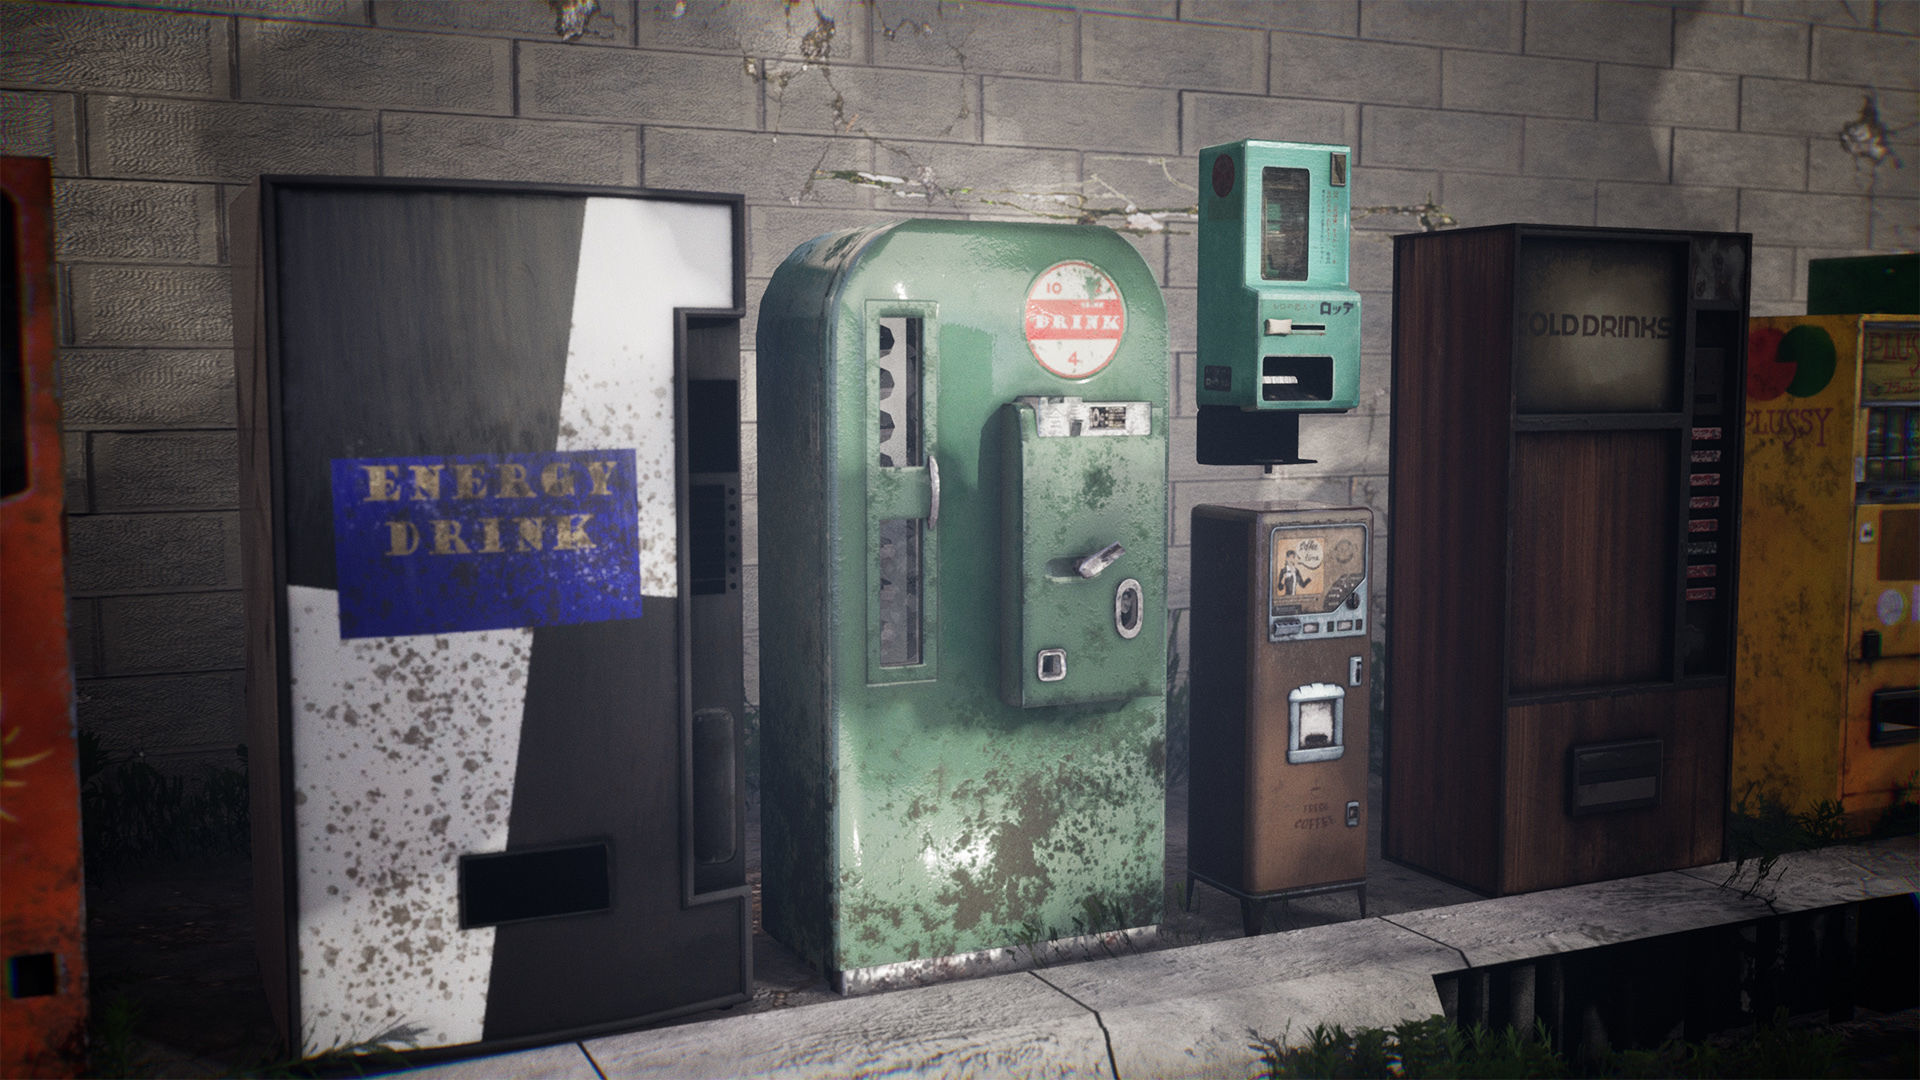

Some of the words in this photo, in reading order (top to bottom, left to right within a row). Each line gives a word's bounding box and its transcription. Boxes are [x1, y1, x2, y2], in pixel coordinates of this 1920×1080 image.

[1046, 282, 1062, 295] 10
[1320, 301, 1354, 315] ロッテ
[1034, 314, 1120, 331] DRINK
[1521, 312, 1579, 337] OLD
[1582, 315, 1673, 339] DRINKS
[1067, 352, 1080, 366] 4
[358, 461, 618, 502] ENERGY
[384, 514, 598, 557] DRINK
